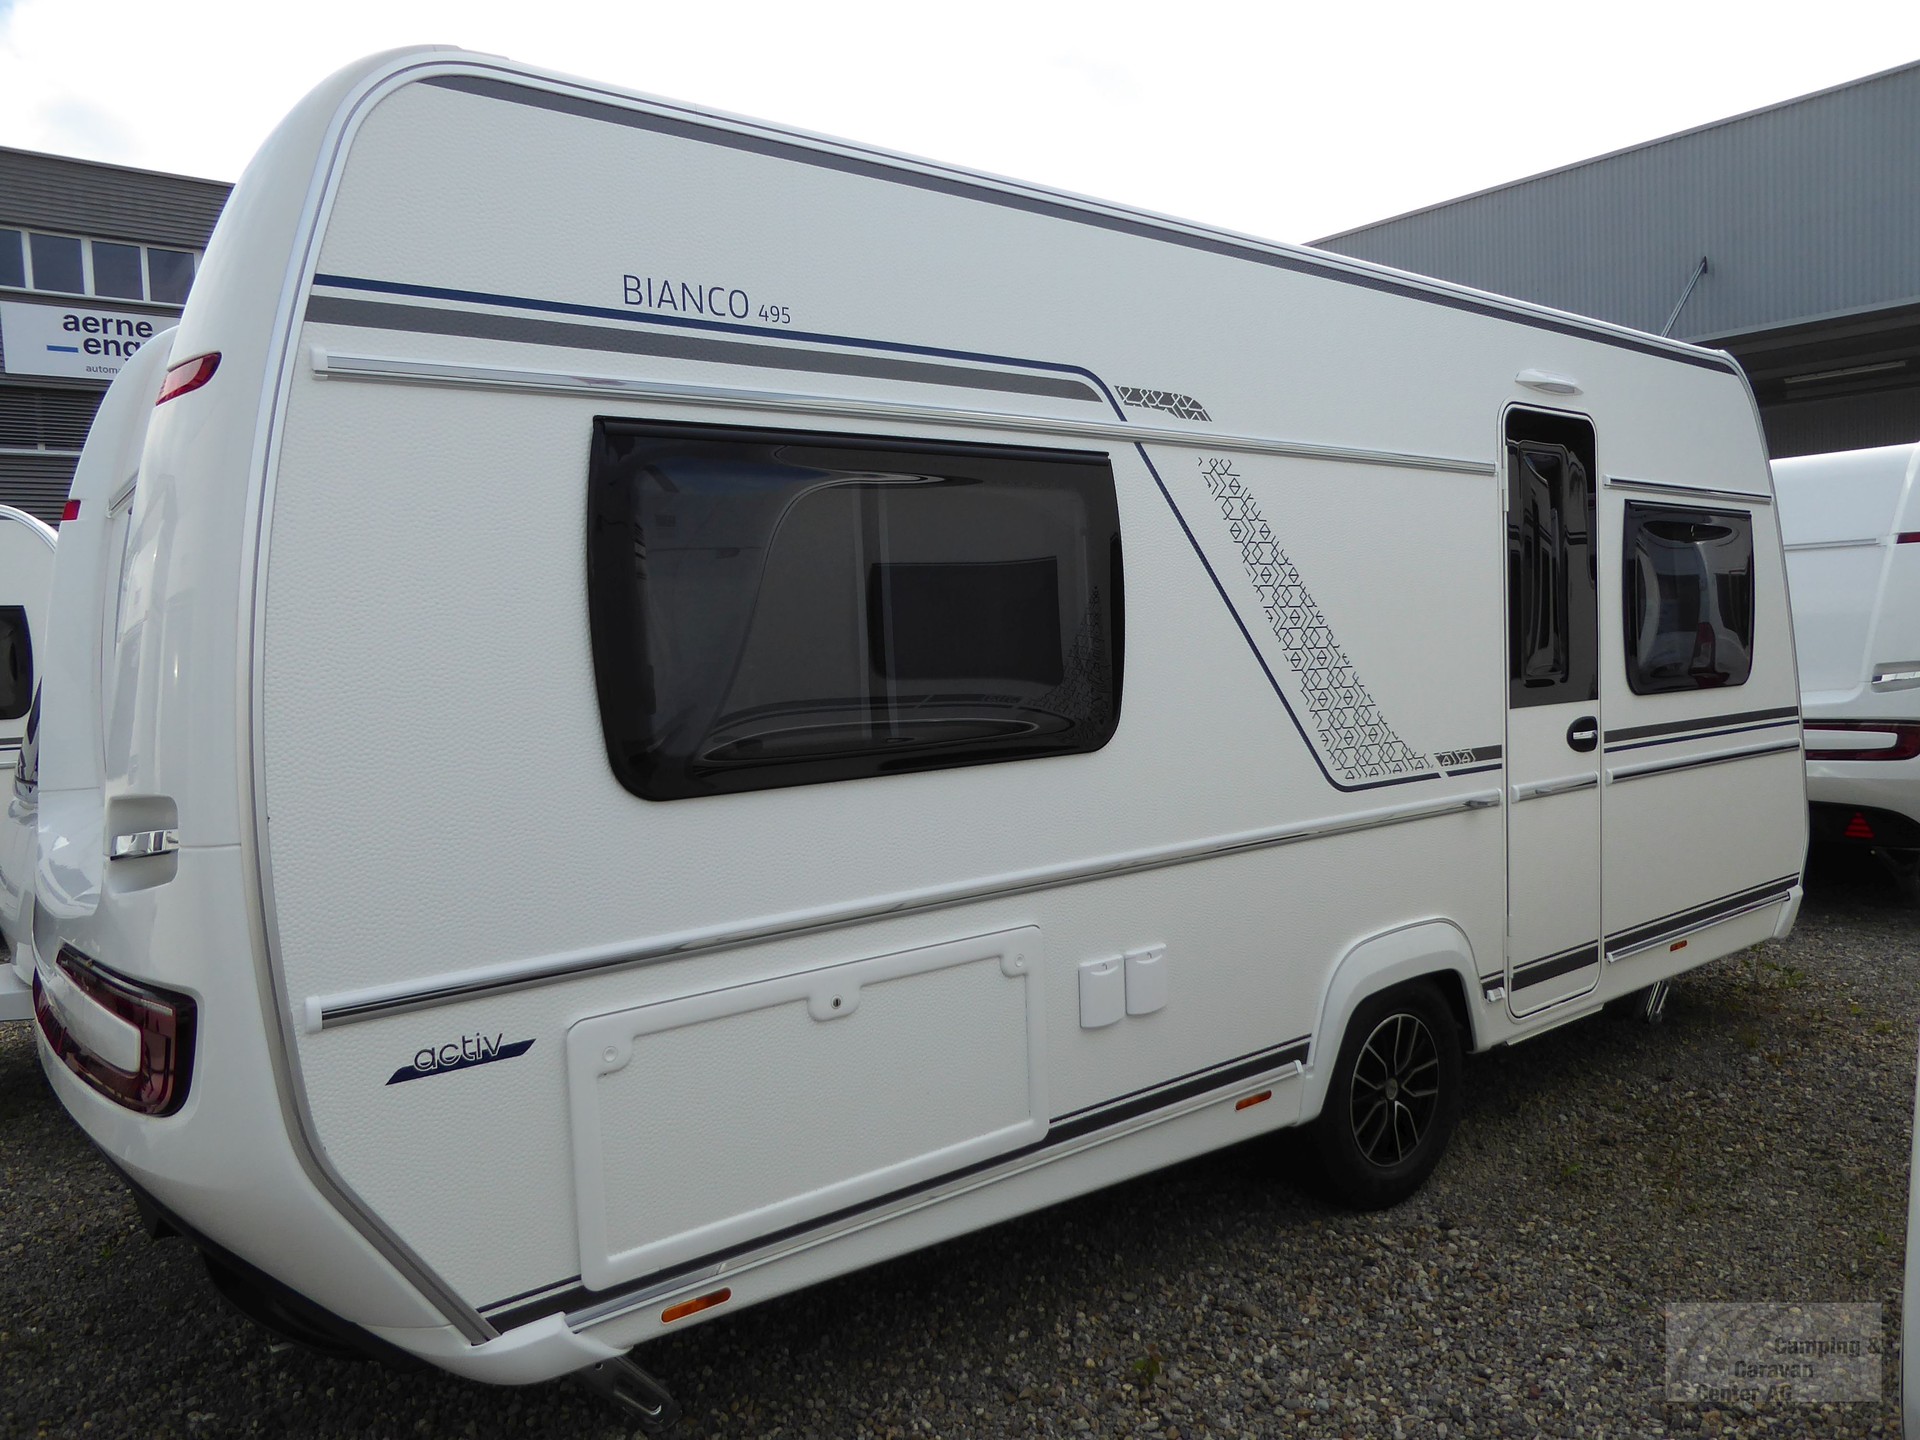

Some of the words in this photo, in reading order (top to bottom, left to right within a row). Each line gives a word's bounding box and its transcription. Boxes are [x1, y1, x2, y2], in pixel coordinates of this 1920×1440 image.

[623, 274, 749, 319] BIANCO
[758, 304, 791, 324] 495
[62, 314, 153, 338] aerne
[83, 337, 144, 362] eng
[85, 365, 121, 375] autom
[413, 1032, 504, 1072] activ
